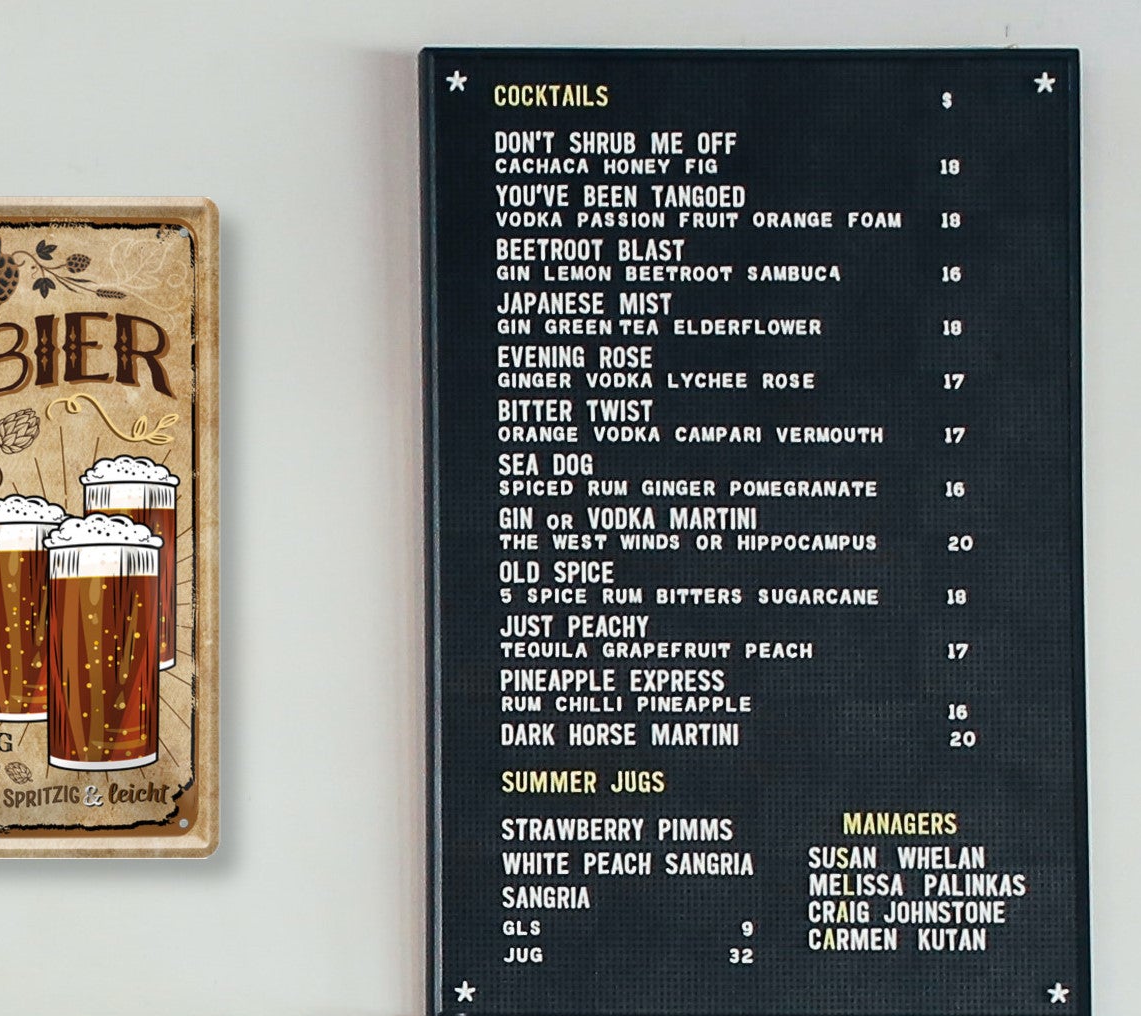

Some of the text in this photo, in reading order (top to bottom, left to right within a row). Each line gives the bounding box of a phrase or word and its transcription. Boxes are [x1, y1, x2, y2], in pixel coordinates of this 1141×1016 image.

[494, 84, 953, 110] COCKTAILS $
[494, 130, 737, 155] DON'T SHRUB ME OFF
[495, 157, 960, 176] CACHACA HONEY FIG 18
[495, 183, 746, 209] YOU'VE BEEN TANGOED
[495, 211, 961, 229] VODKA PASSION FRUIT ORANGE FOAM 18
[496, 238, 685, 262] BEETROOT BLAST
[496, 265, 962, 283] GIN LEMON BEETROOT SAMBUCA 16
[496, 291, 672, 316] JAPANESE MIST
[497, 318, 962, 336] GIN GREEN TEA ELDERFLOWER 18
[497, 345, 653, 370] EVENING ROSE
[498, 399, 653, 423] BITTER TWIST
[498, 453, 594, 476] SEA DOG
[499, 479, 965, 498] SPICED RUM GINGER POMEGRANATE 16
[499, 506, 757, 531] GIN OR VODKA MARTINI
[499, 533, 974, 552] THE WEST WINDS OR HIPPOCAMPUS 20
[499, 560, 614, 584] OLD SPICE
[499, 614, 649, 639] JUST PEACHY
[500, 641, 969, 660] TEQUILA GRAPEFRUIT PEACH 17
[500, 668, 725, 693] PINEAPPLE EXPRESS
[501, 695, 752, 713] RUM CHILLI PINEAPPLE
[947, 703, 968, 721] 16
[501, 722, 977, 748] DARK HORSE MARTINI 20
[501, 770, 665, 794] SUMMER JUGS
[2, 784, 81, 809] SPRITZIG
[82, 784, 105, 808] &
[107, 781, 172, 805] leicht
[501, 817, 734, 842] STRAWBERRY PIMMS
[843, 812, 958, 836] MANAGERS
[502, 851, 754, 876] WHITE PEACH SANGRIA
[808, 845, 985, 870] SUSAN WHELAN
[502, 885, 591, 910] SANGRIA
[809, 873, 1027, 898] MELISSA PALINKAS
[808, 900, 1006, 924] CRAIG JOHNSTONE
[502, 920, 754, 937] GLS 9
[808, 927, 986, 952] CARMEN KUTAN
[503, 946, 754, 964] JUG 32
